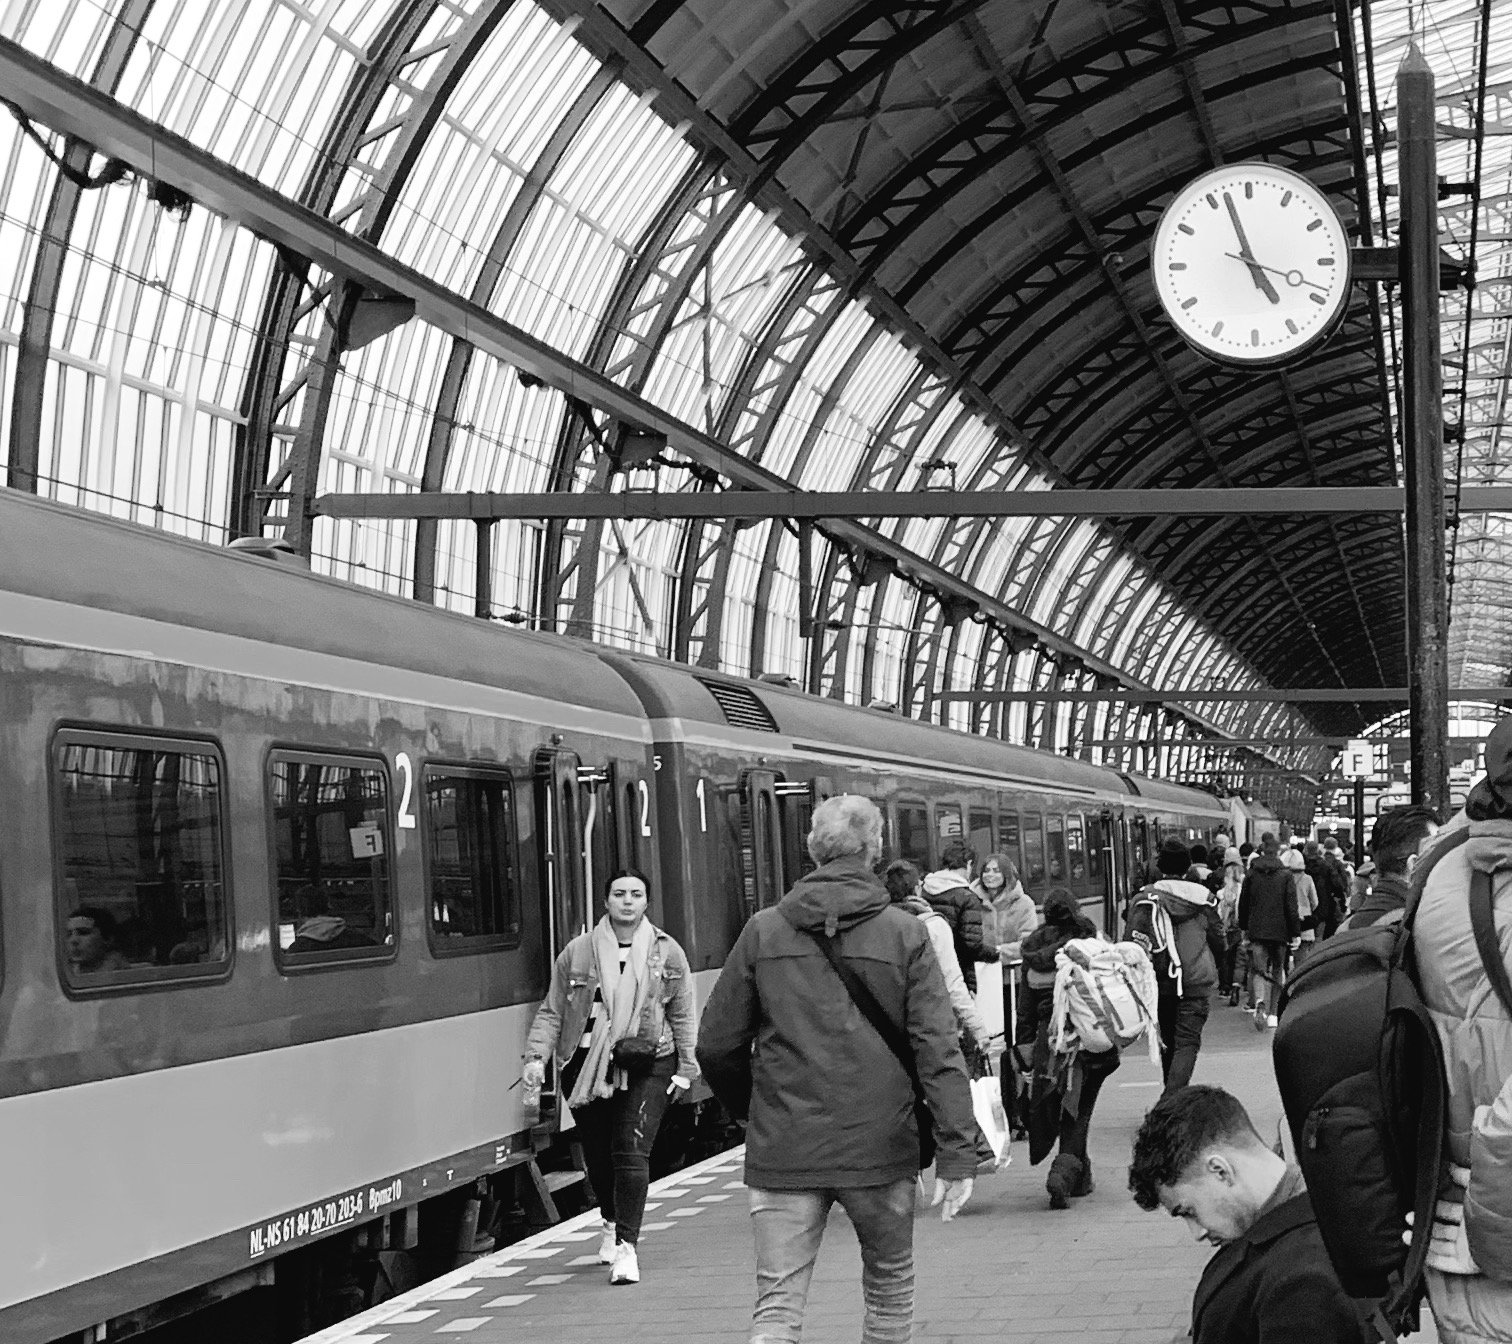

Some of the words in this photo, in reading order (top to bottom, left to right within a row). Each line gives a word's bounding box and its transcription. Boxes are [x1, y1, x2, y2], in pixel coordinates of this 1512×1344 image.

[395, 752, 416, 829] 2
[653, 755, 662, 771] 5
[1352, 753, 1363, 772] F
[638, 779, 651, 837] 2
[696, 778, 707, 832] 1
[250, 1221, 282, 1255] NL-NS
[282, 1216, 295, 1242] 61
[297, 1211, 309, 1236] 84
[310, 1202, 337, 1231] 20-70
[338, 1191, 363, 1222] 203-6
[369, 1178, 402, 1214] Bpmz10
